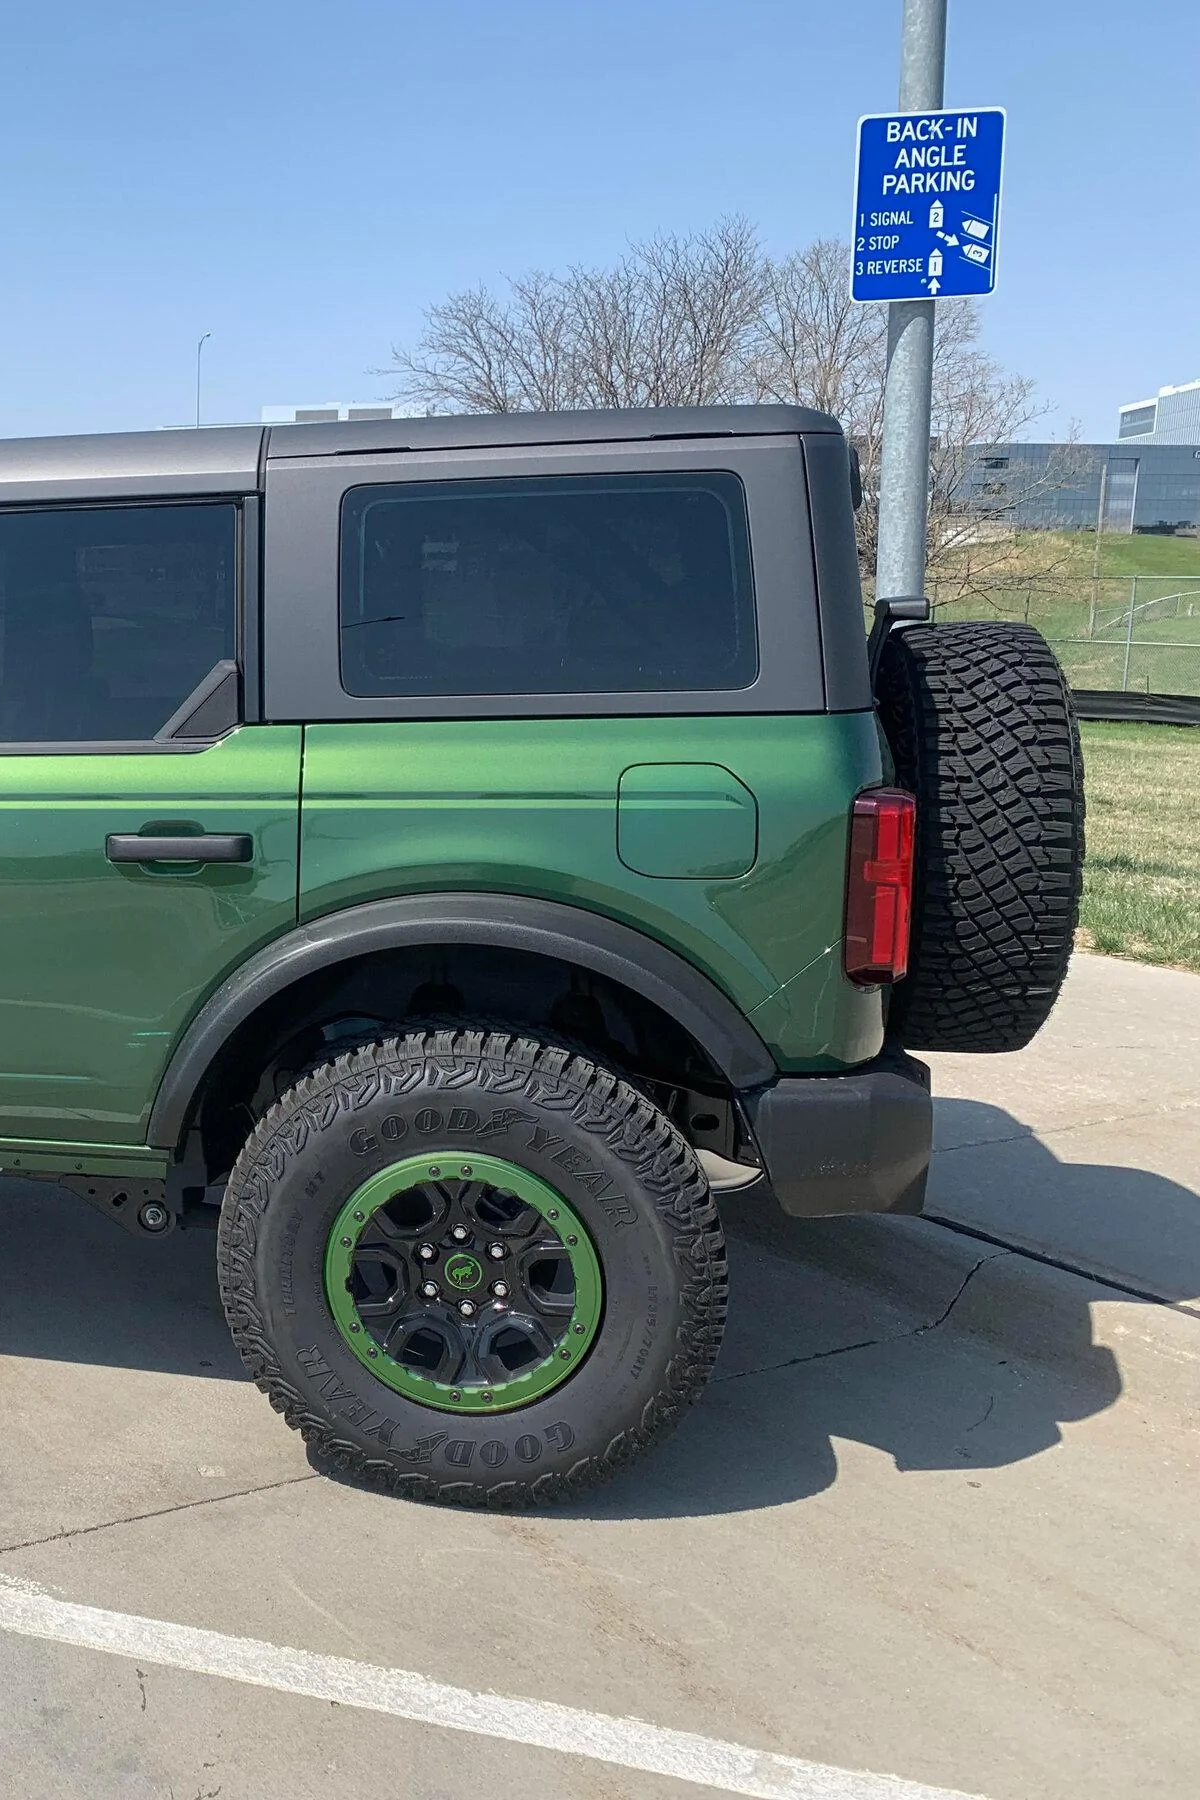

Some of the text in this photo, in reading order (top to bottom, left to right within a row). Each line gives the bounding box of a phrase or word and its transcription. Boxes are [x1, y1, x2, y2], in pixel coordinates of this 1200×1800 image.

[886, 116, 978, 142] BACK-IN
[894, 145, 967, 169] ANGLE
[882, 170, 976, 195] PARKING
[860, 210, 914, 227] 1 SIGNAL
[932, 211, 940, 223] 2
[856, 235, 900, 252] 2 STOP
[855, 258, 924, 276] 3 REVERSE
